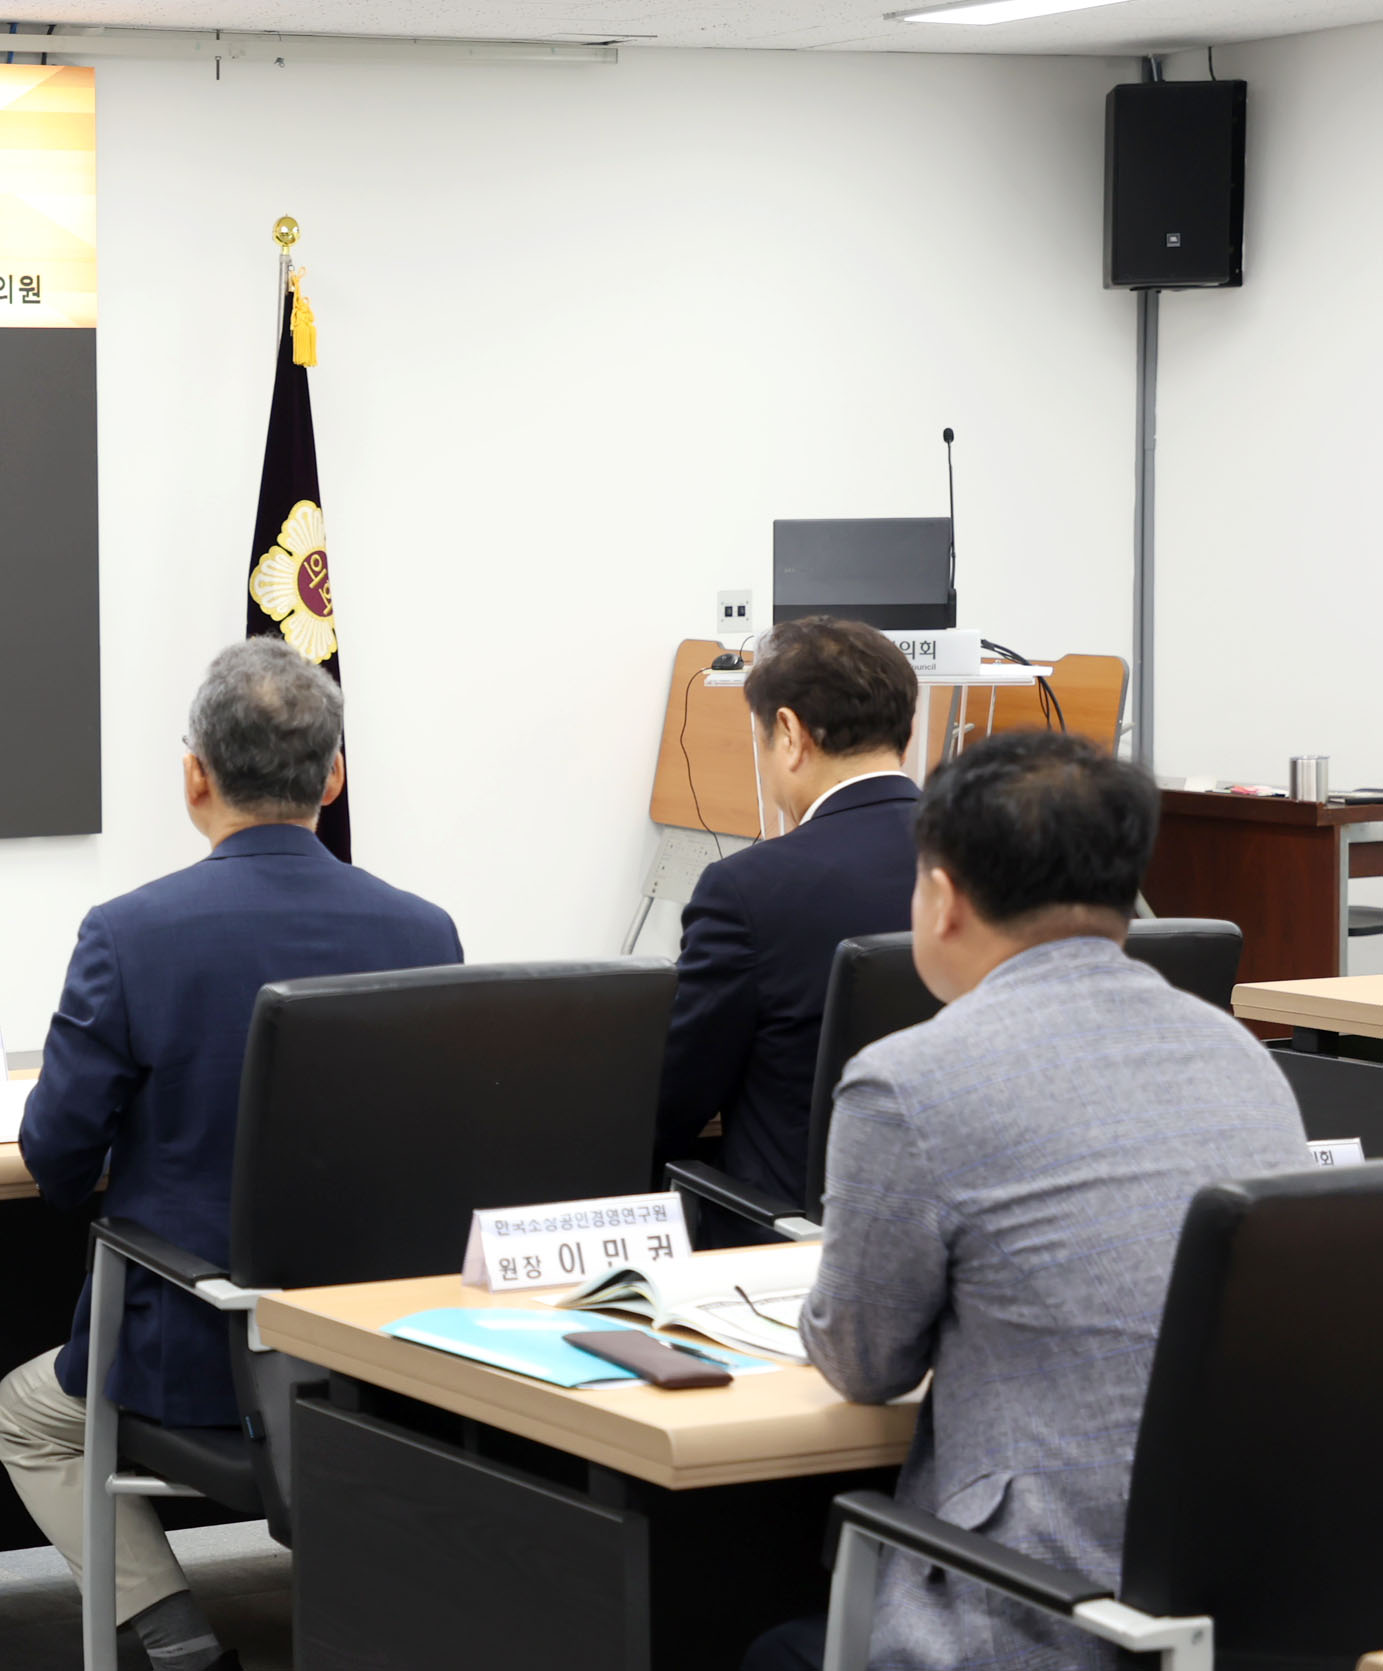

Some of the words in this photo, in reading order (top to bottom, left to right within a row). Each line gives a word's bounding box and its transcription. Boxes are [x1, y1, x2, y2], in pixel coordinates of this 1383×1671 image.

[893, 640, 936, 660] 의회
[494, 1204, 667, 1236] 한국소상공인경영연구원
[498, 1256, 541, 1281] 원장
